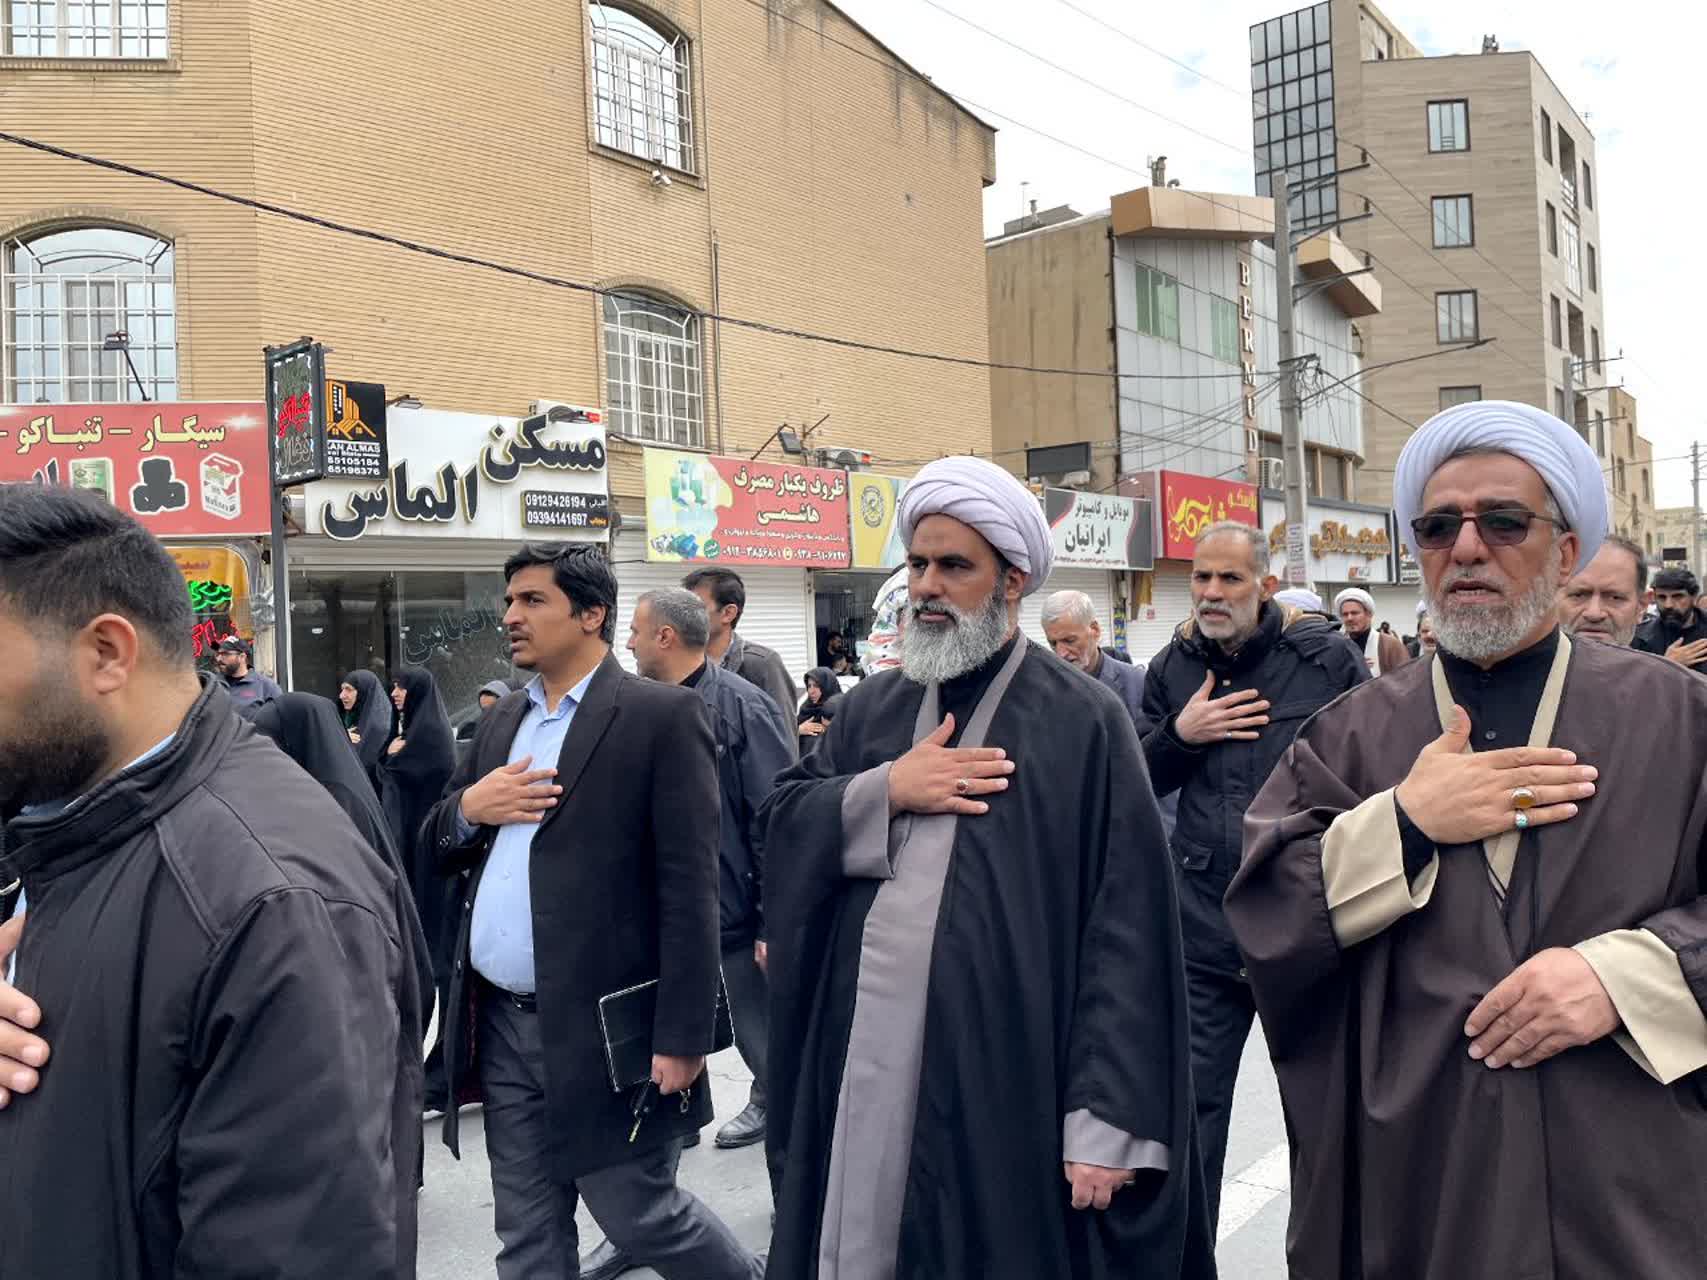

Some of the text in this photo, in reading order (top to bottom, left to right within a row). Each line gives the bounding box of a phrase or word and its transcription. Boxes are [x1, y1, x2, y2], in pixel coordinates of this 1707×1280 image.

[16, 415, 103, 454] تنباکو
[139, 415, 226, 452] سیگار
[346, 443, 380, 453] ALMAS
[481, 413, 607, 483] مسکن
[321, 458, 480, 540] الماس
[733, 466, 845, 501] ظروف یکبار مصرف
[757, 503, 820, 525] هاشمی
[1065, 523, 1111, 554] ایرانیان
